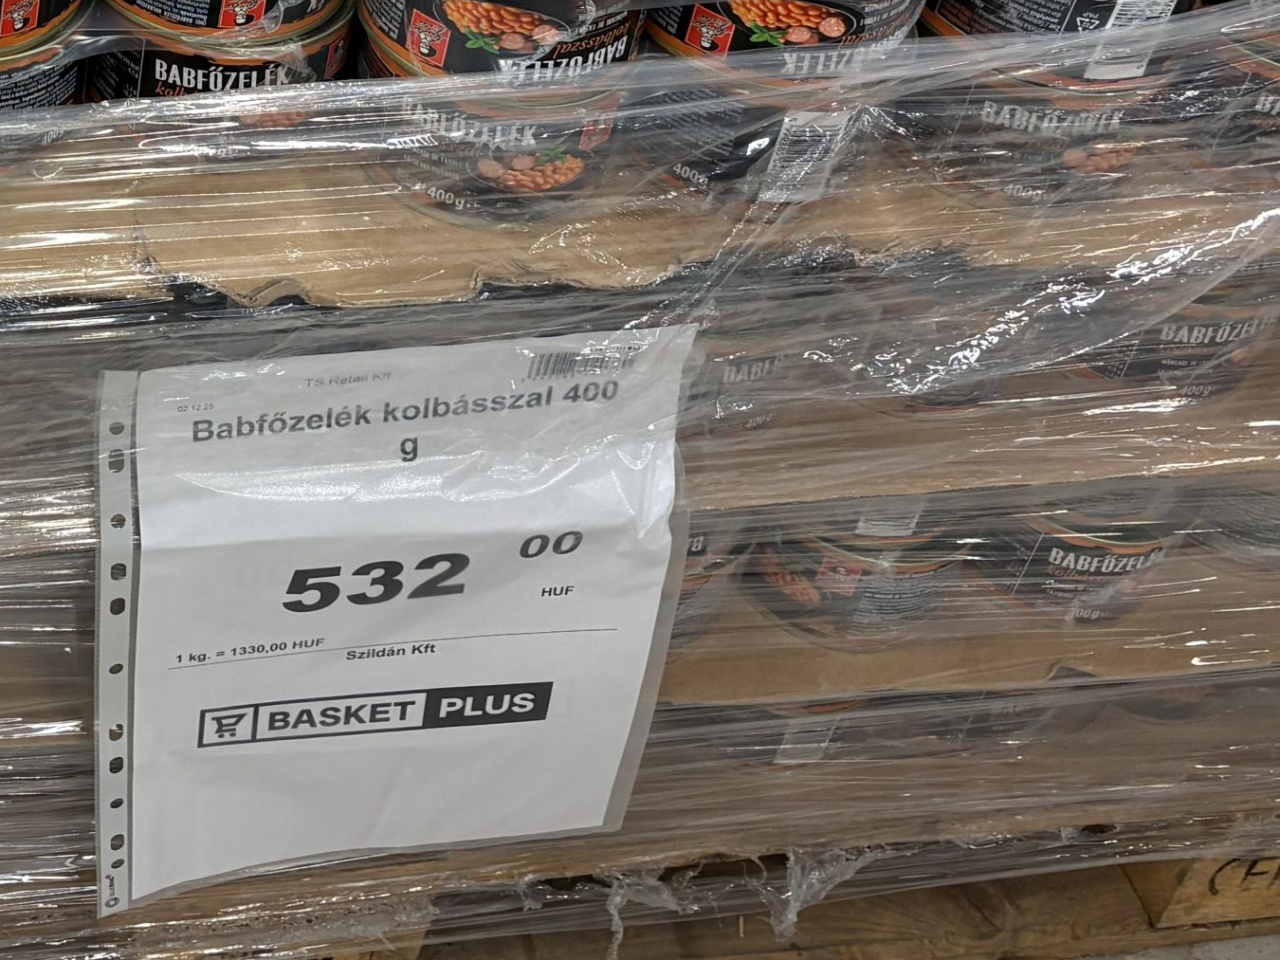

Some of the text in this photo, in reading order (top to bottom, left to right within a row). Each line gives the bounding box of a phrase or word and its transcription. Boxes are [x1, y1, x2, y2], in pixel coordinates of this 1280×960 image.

[154, 58, 289, 90] BABFŐZELÉK
[192, 380, 619, 442] Babfőzelék kolbásszal 400
[400, 437, 419, 462] g
[282, 531, 583, 613] 532 00
[540, 585, 575, 598] HUF
[175, 654, 183, 664] 1
[188, 651, 211, 667] kg.
[230, 641, 288, 658] 1330,00
[292, 638, 325, 651] HUF
[346, 643, 437, 661] Szildán Kft
[268, 692, 536, 732] BASKET PLUS
